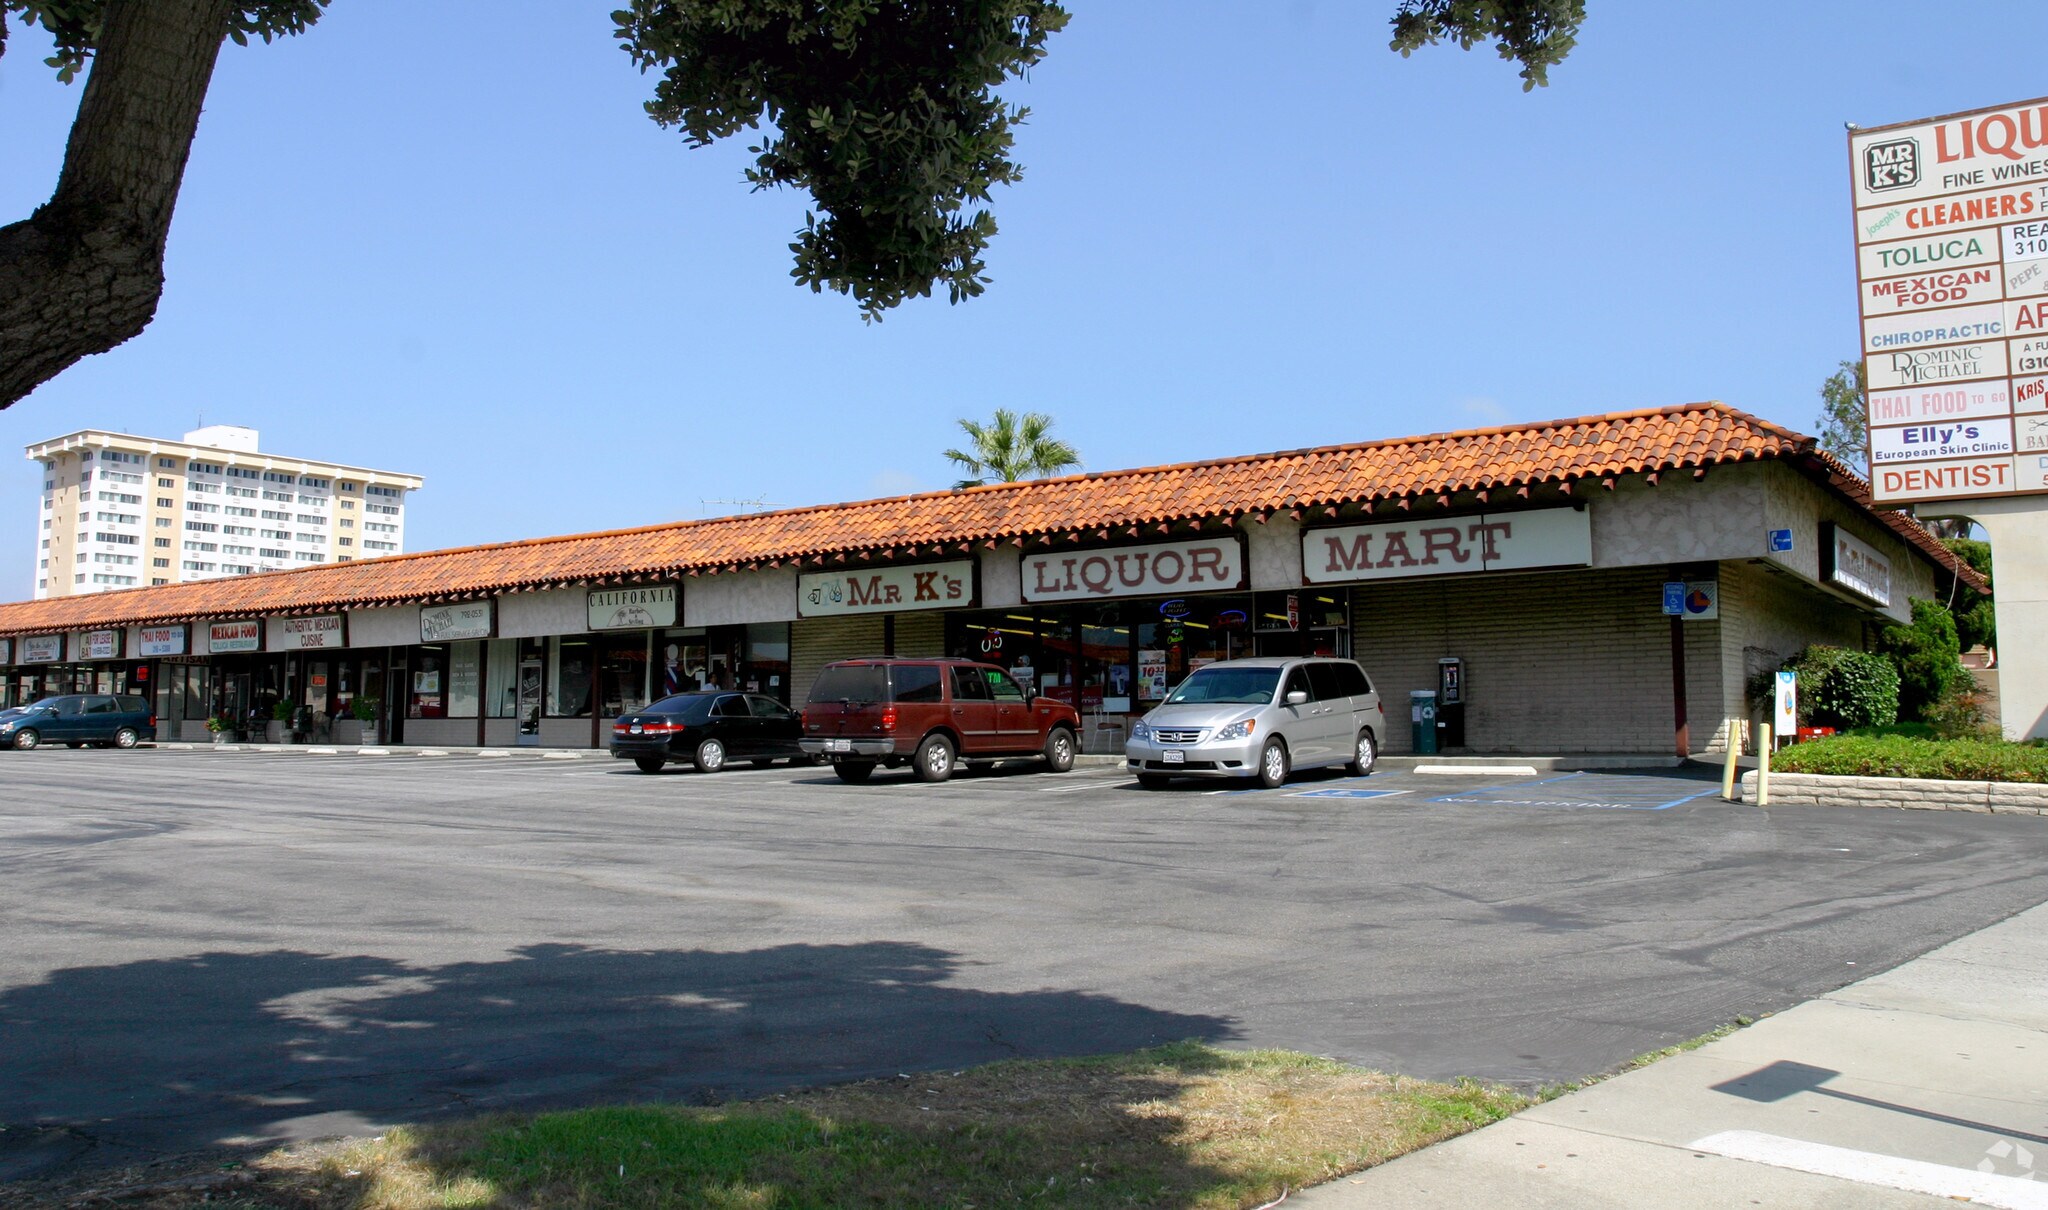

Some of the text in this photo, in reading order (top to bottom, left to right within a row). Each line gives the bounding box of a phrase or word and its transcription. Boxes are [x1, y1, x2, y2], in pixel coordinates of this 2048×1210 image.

[1871, 144, 1913, 167] MR
[1872, 162, 1914, 187] K'S
[1943, 159, 2048, 189] FINE WINES
[1866, 191, 2034, 238] Joseph's CLEANERS
[1877, 238, 1983, 268] TOLUCA
[1872, 269, 1991, 298] MEXICAN
[2009, 263, 2042, 290] PEPE
[1896, 287, 1968, 308] FOOD
[1871, 321, 2001, 348] CHIROPRACTIC
[1891, 346, 1983, 372] DOMINIC
[1900, 361, 1981, 385] MICHAEL
[2016, 379, 2045, 403] KRIS
[1872, 390, 2006, 420] THAI FOOD TO GO
[1902, 425, 1979, 445] Elly's
[1875, 442, 2009, 461] European Skin Clinic
[1883, 463, 2010, 493] DENTIST
[1324, 521, 1512, 573] MART
[1034, 547, 1229, 594] LIQUOR
[590, 589, 673, 608] CALIFORNIA
[142, 631, 153, 643] THAI
[155, 630, 170, 642] FOOD
[211, 624, 257, 640] MEXICAN FOOD
[285, 617, 340, 634] AUTHENTIC MEXICAN
[301, 634, 324, 647] CUISINE
